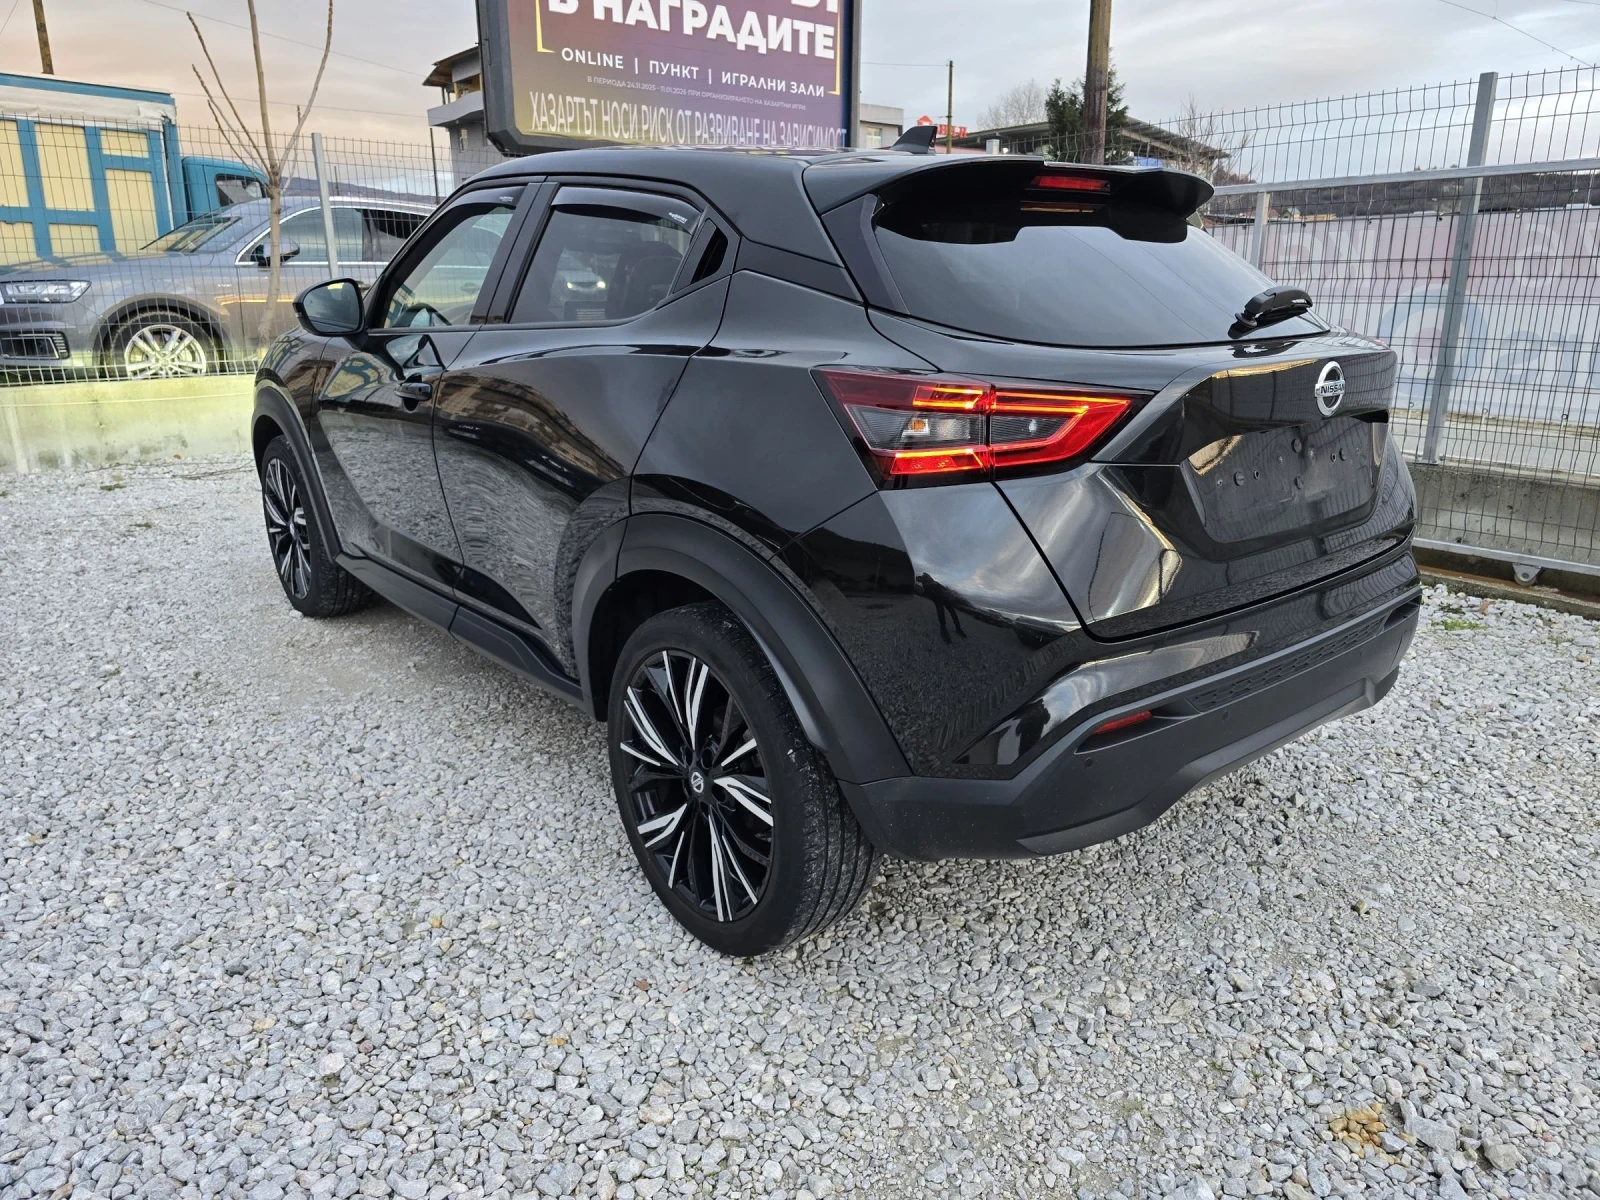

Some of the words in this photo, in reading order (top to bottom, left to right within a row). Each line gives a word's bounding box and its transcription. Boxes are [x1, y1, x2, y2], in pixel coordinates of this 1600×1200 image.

[593, 0, 835, 60] НАГРАДИТЕ
[561, 47, 624, 69] ONLINE
[649, 60, 699, 80] ПУНКТ
[721, 71, 786, 93] ИГРАЛНИ
[790, 81, 825, 98] ЗАЛИ
[593, 77, 627, 88] ПЕРИОДА
[529, 91, 598, 136] ХАЗАРТЪТ
[602, 100, 639, 140] НОСИ
[641, 105, 675, 144] РИСК
[676, 109, 692, 144] ОТ
[694, 111, 760, 145] РАЗВИВАНЕ
[1320, 382, 1344, 394] NISSAN
